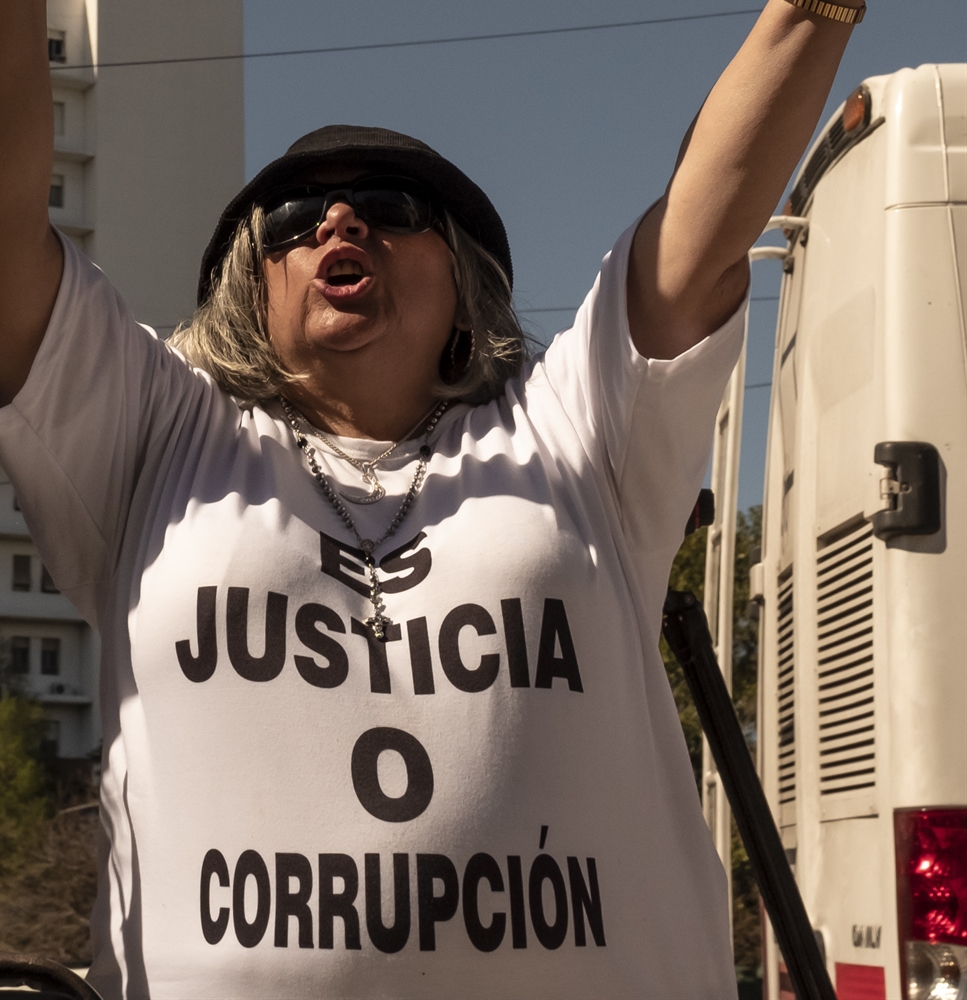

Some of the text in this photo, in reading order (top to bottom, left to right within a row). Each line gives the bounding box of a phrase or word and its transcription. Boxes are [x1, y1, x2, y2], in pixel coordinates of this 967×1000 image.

[319, 530, 433, 599] ES
[174, 584, 585, 696] JUSTICIA
[350, 726, 435, 824] O
[198, 825, 607, 955] CORRUPCIÓN
